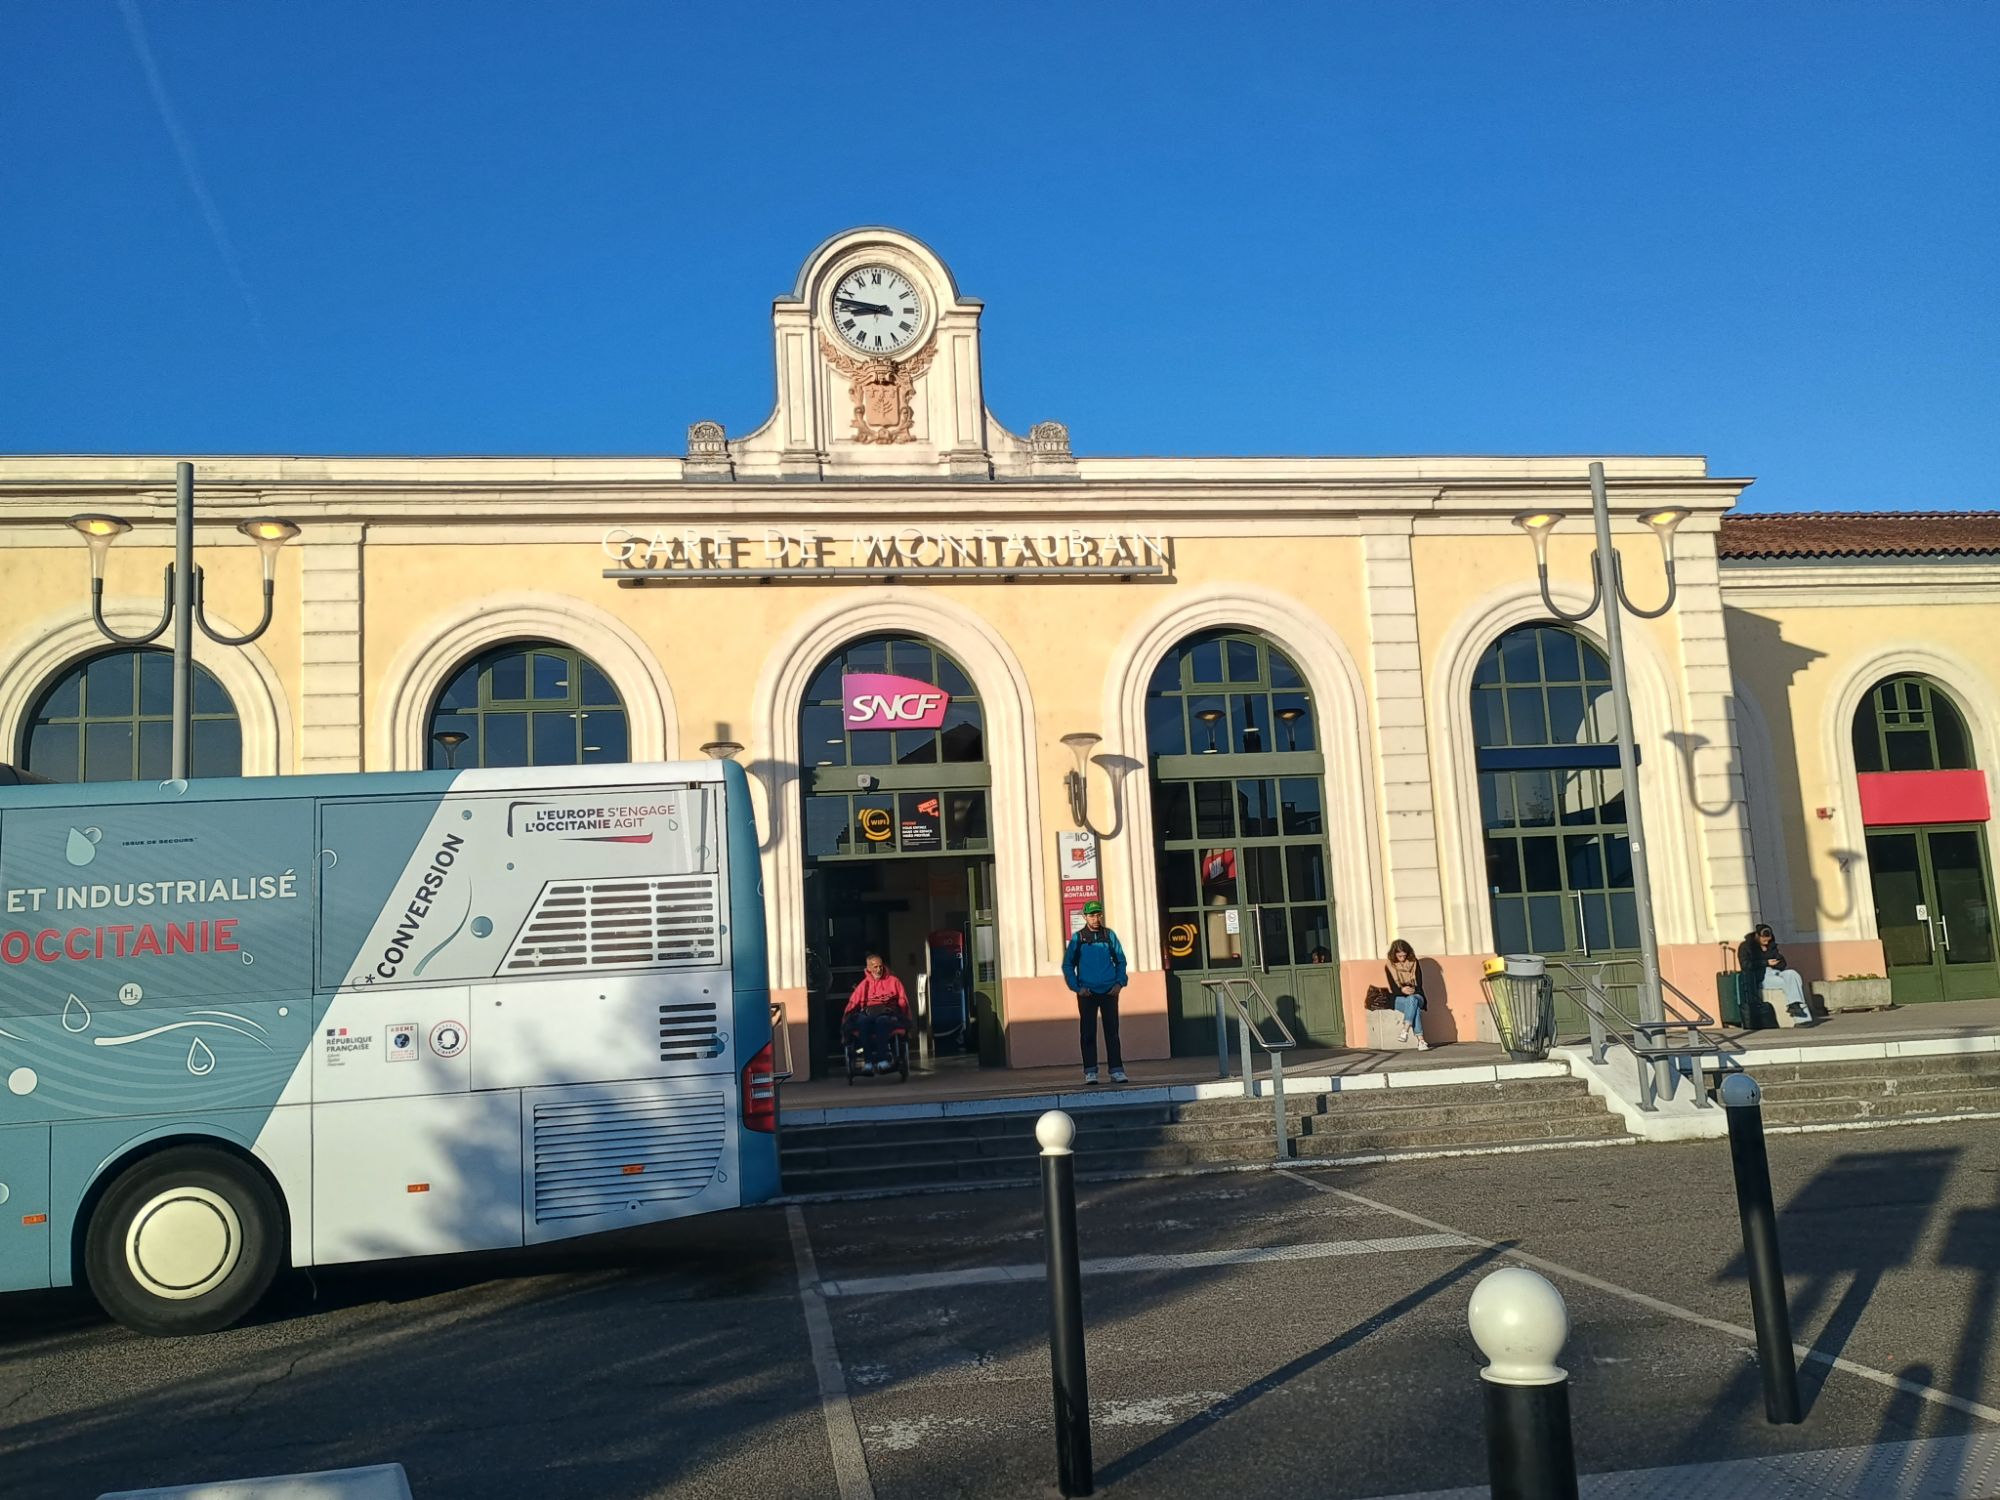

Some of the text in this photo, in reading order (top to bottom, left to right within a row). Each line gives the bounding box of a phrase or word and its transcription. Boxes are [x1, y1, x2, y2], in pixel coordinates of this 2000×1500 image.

[602, 527, 1164, 561] GARE DE MONTAUBAN
[849, 694, 941, 722] SNCF
[537, 804, 676, 821] L'EUROPE S'ENGAGE
[525, 817, 645, 833] L'OCCITANIE AGIT
[7, 869, 297, 913] ET INDUSTRIALISÉ
[1065, 885, 1084, 893] GARE
[377, 833, 464, 978] CONVERSION
[1, 919, 240, 966] OCCITANIE
[326, 1036, 373, 1046] RÉPUBLIQUE
[326, 1043, 370, 1053] FRANÇAISE
